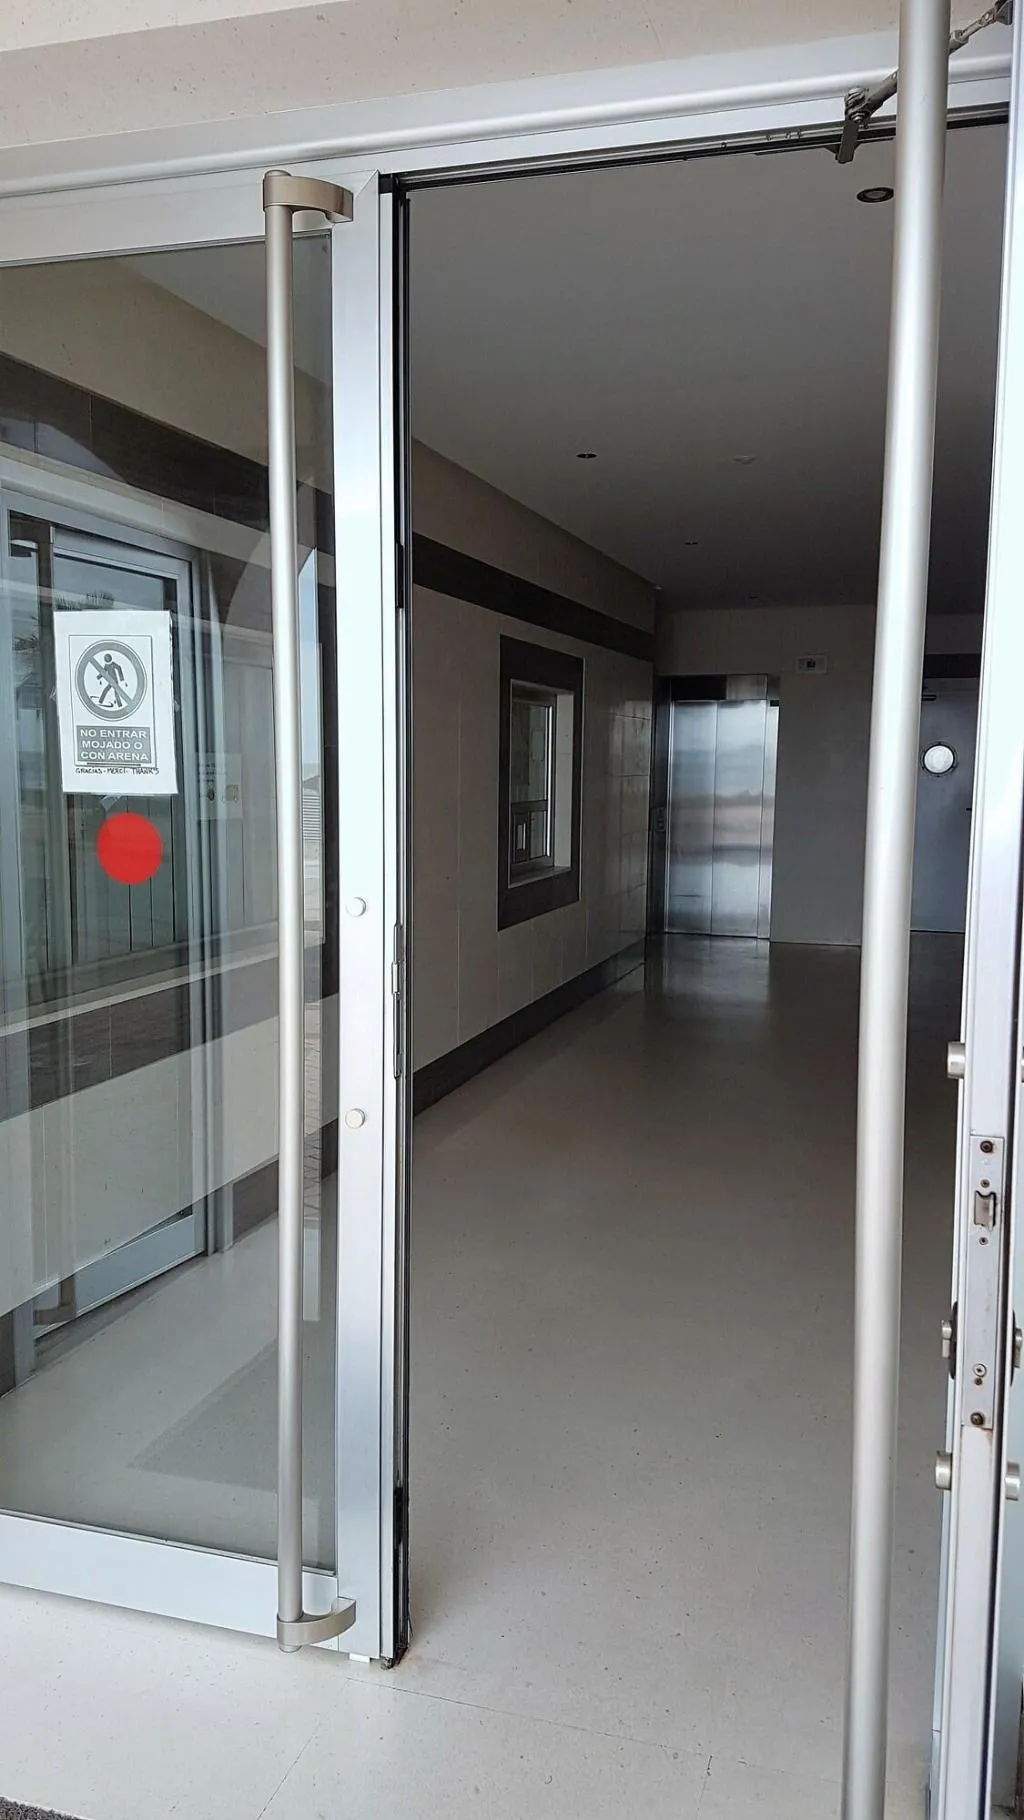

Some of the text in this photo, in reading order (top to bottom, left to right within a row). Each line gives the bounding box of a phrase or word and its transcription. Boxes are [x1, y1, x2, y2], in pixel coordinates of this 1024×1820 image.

[80, 729, 147, 739] NO ENTRAR
[82, 740, 143, 750] MOJADO O
[80, 751, 149, 761] CON ARENA
